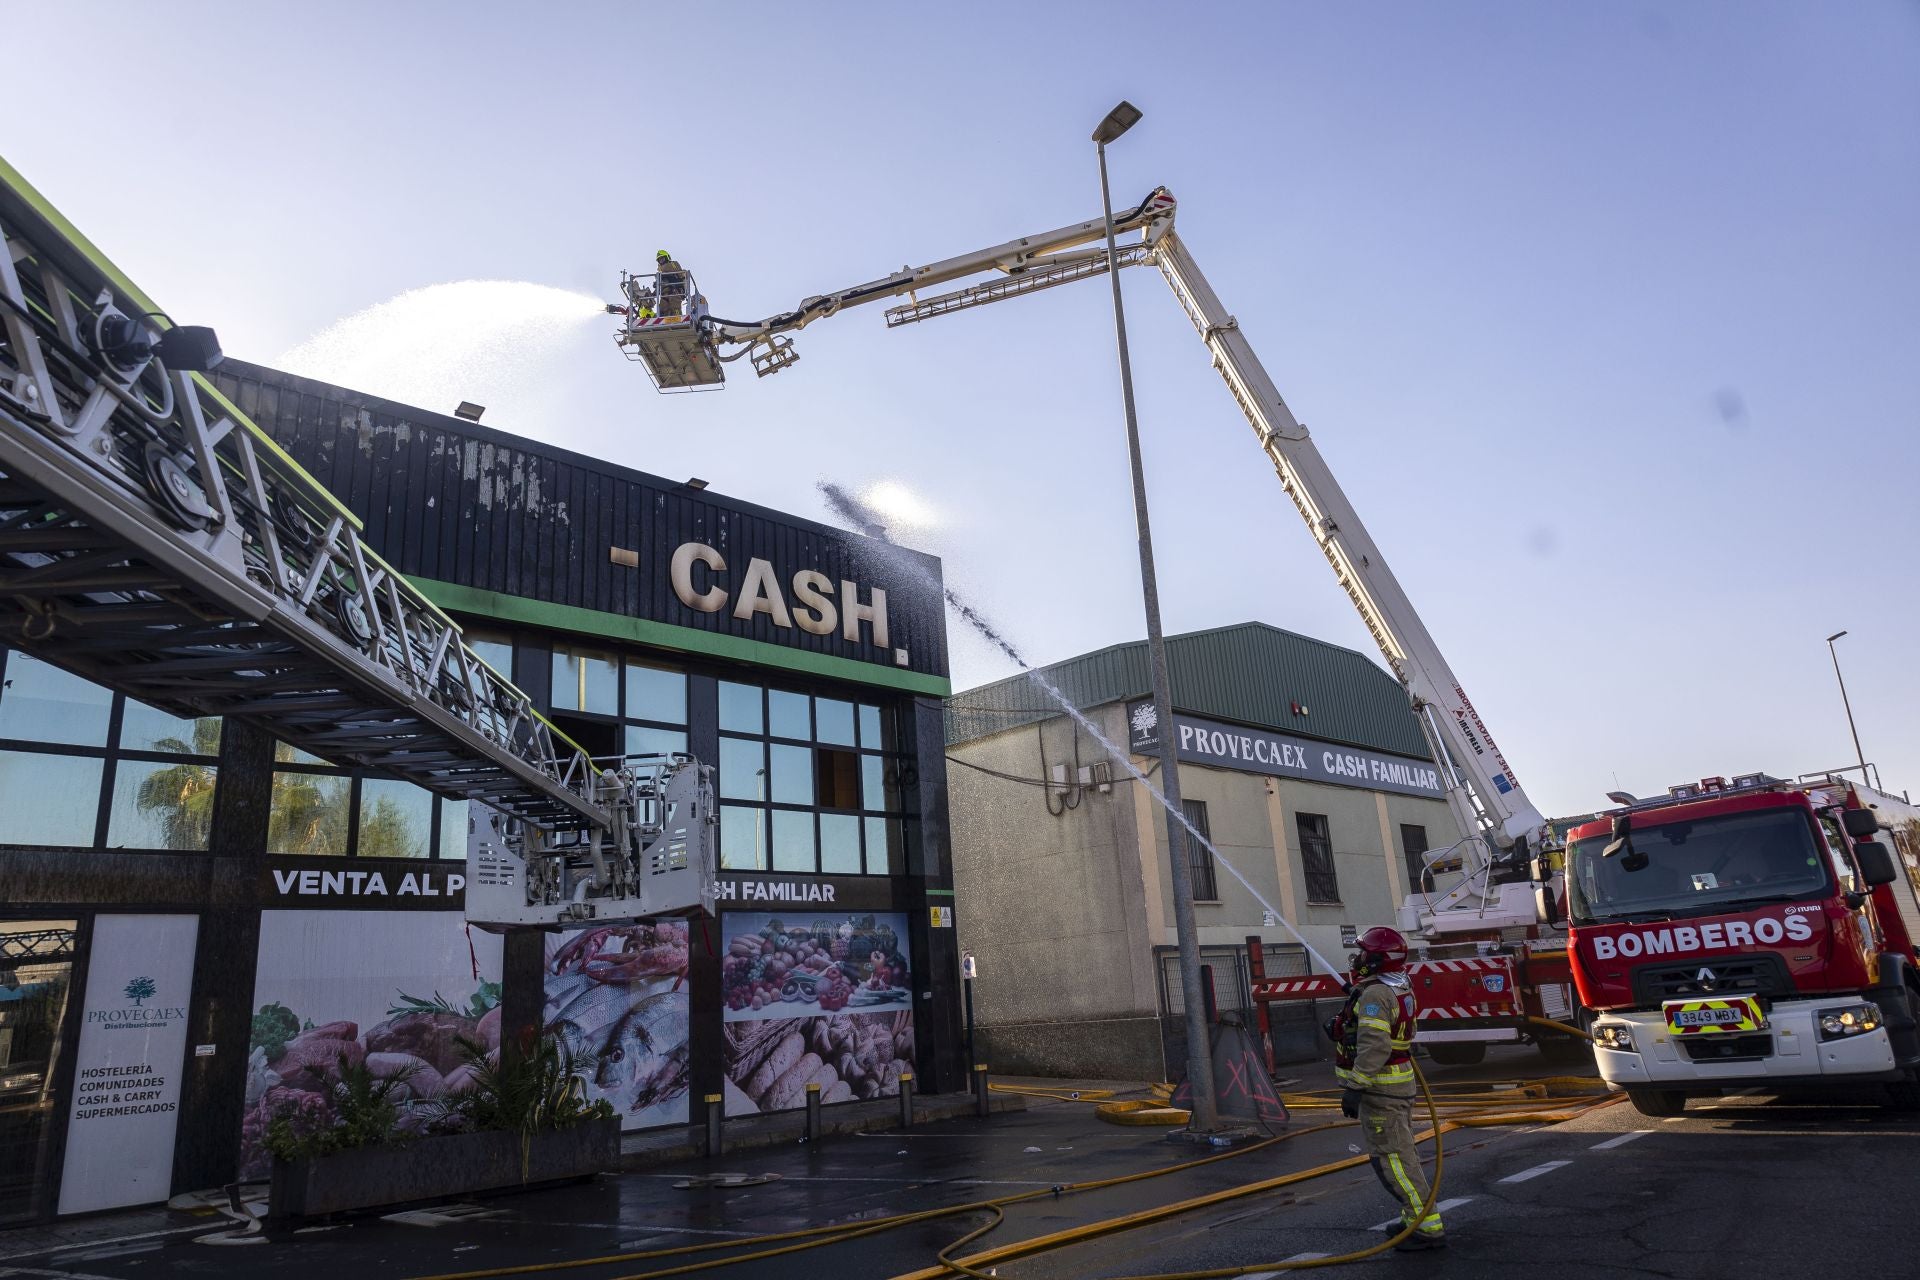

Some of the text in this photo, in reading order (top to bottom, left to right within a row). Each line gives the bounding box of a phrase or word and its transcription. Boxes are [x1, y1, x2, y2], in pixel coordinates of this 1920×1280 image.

[1455, 686, 1479, 721] BRONTO
[1474, 719, 1499, 752] SKYLIFT
[1178, 724, 1440, 791] PROVECAEX CASH FAMILIAR
[272, 869, 389, 896] VENTA
[397, 872, 440, 896] AL
[742, 881, 836, 902] FAMILIAR
[1593, 914, 1812, 960] BOMBEROS
[88, 1007, 185, 1023] PROVECAEX
[1714, 1009, 1738, 1021] MBX
[104, 1021, 168, 1031] Distribuciones
[81, 1063, 153, 1079] HOSTELERÍA
[79, 1077, 165, 1092] COMUNIDADES
[77, 1090, 162, 1106] CASH & CARRY
[75, 1102, 176, 1120] SUPERMERCADOS
